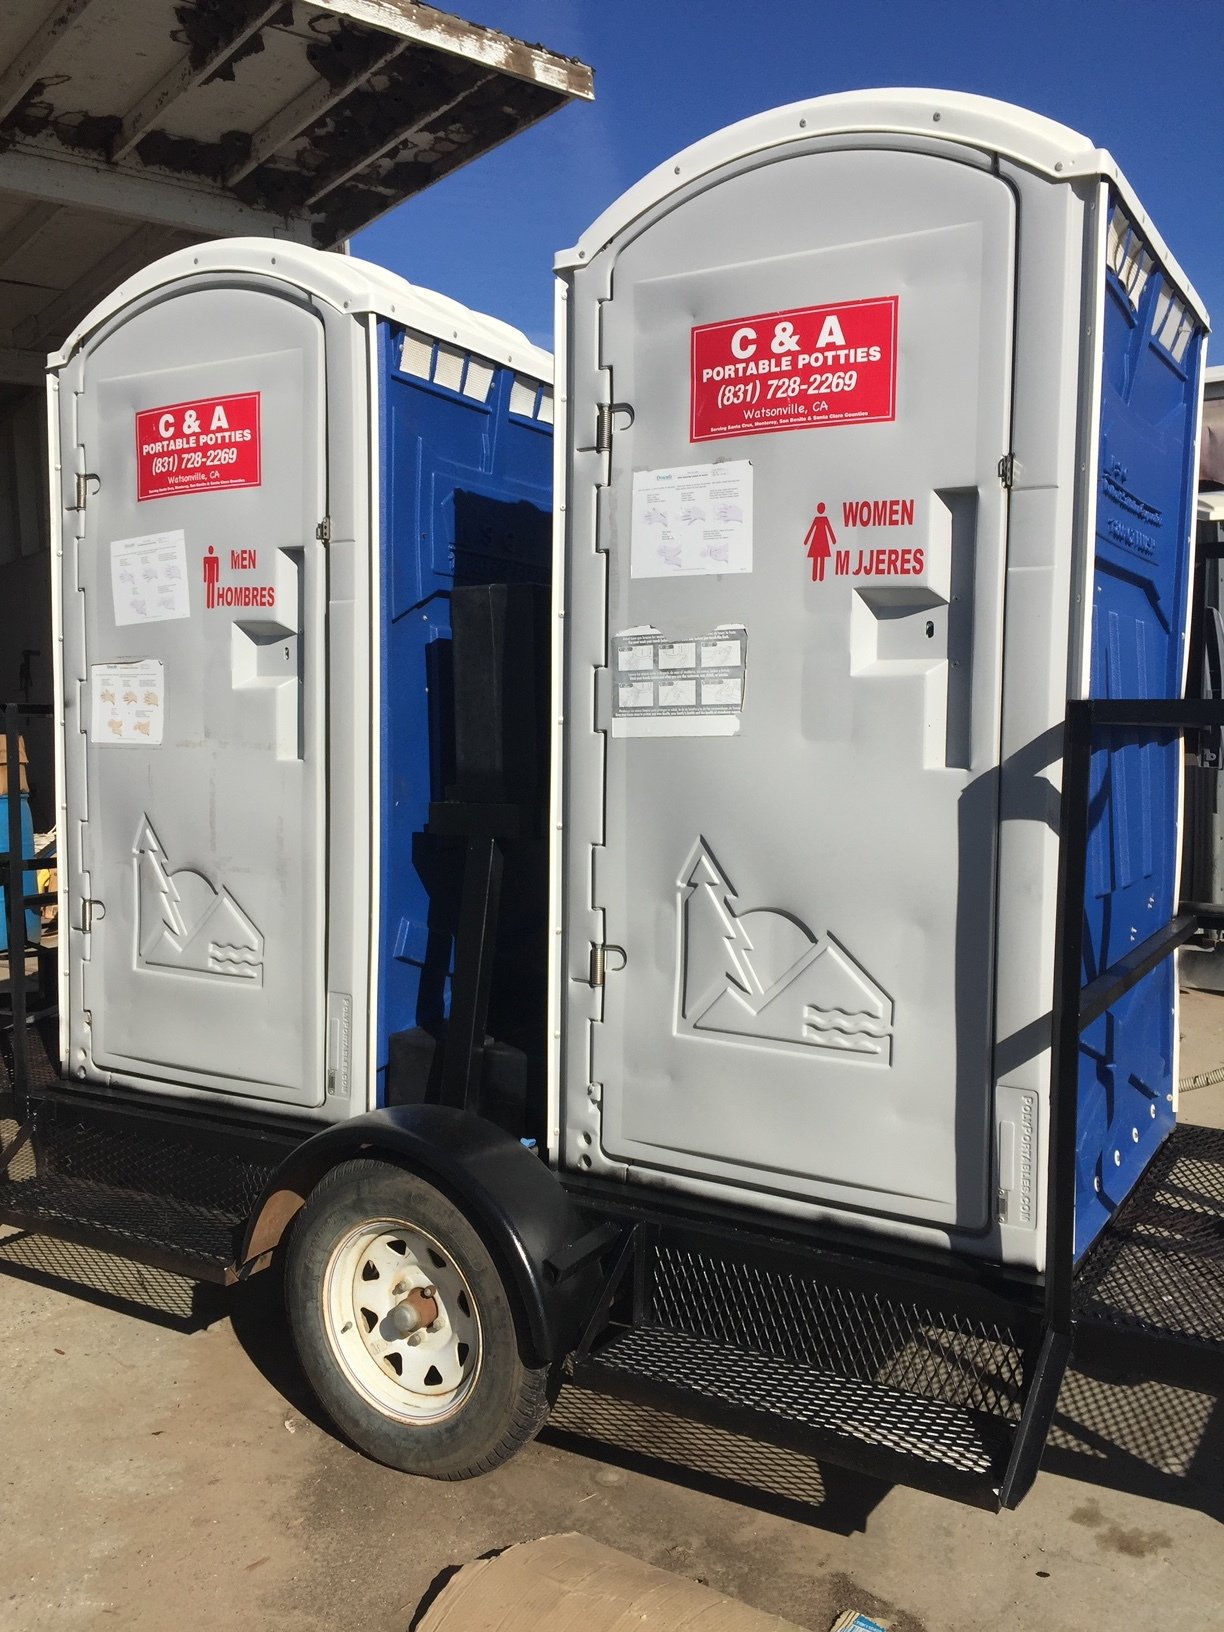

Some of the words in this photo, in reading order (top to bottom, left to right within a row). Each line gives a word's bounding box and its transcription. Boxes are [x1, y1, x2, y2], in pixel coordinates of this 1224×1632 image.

[731, 327, 757, 360] C
[770, 321, 801, 354] &
[816, 315, 846, 348] A
[702, 356, 792, 383] PORTABLE
[798, 346, 882, 368] POTTIES
[717, 380, 761, 408] (831)
[766, 370, 858, 400] 728-2269
[158, 414, 175, 438] C
[182, 410, 201, 434] &
[210, 405, 230, 430] A
[743, 404, 808, 420] Watsonville,
[812, 400, 828, 412] CA
[142, 436, 196, 456] PORTABLE
[200, 429, 252, 446] POTTIES
[152, 454, 178, 476] (831)
[181, 447, 238, 469] 728-2269
[209, 470, 220, 479] CA
[842, 499, 914, 528] WOMEN
[231, 549, 256, 570] MEN
[217, 586, 275, 607] HOMBRES
